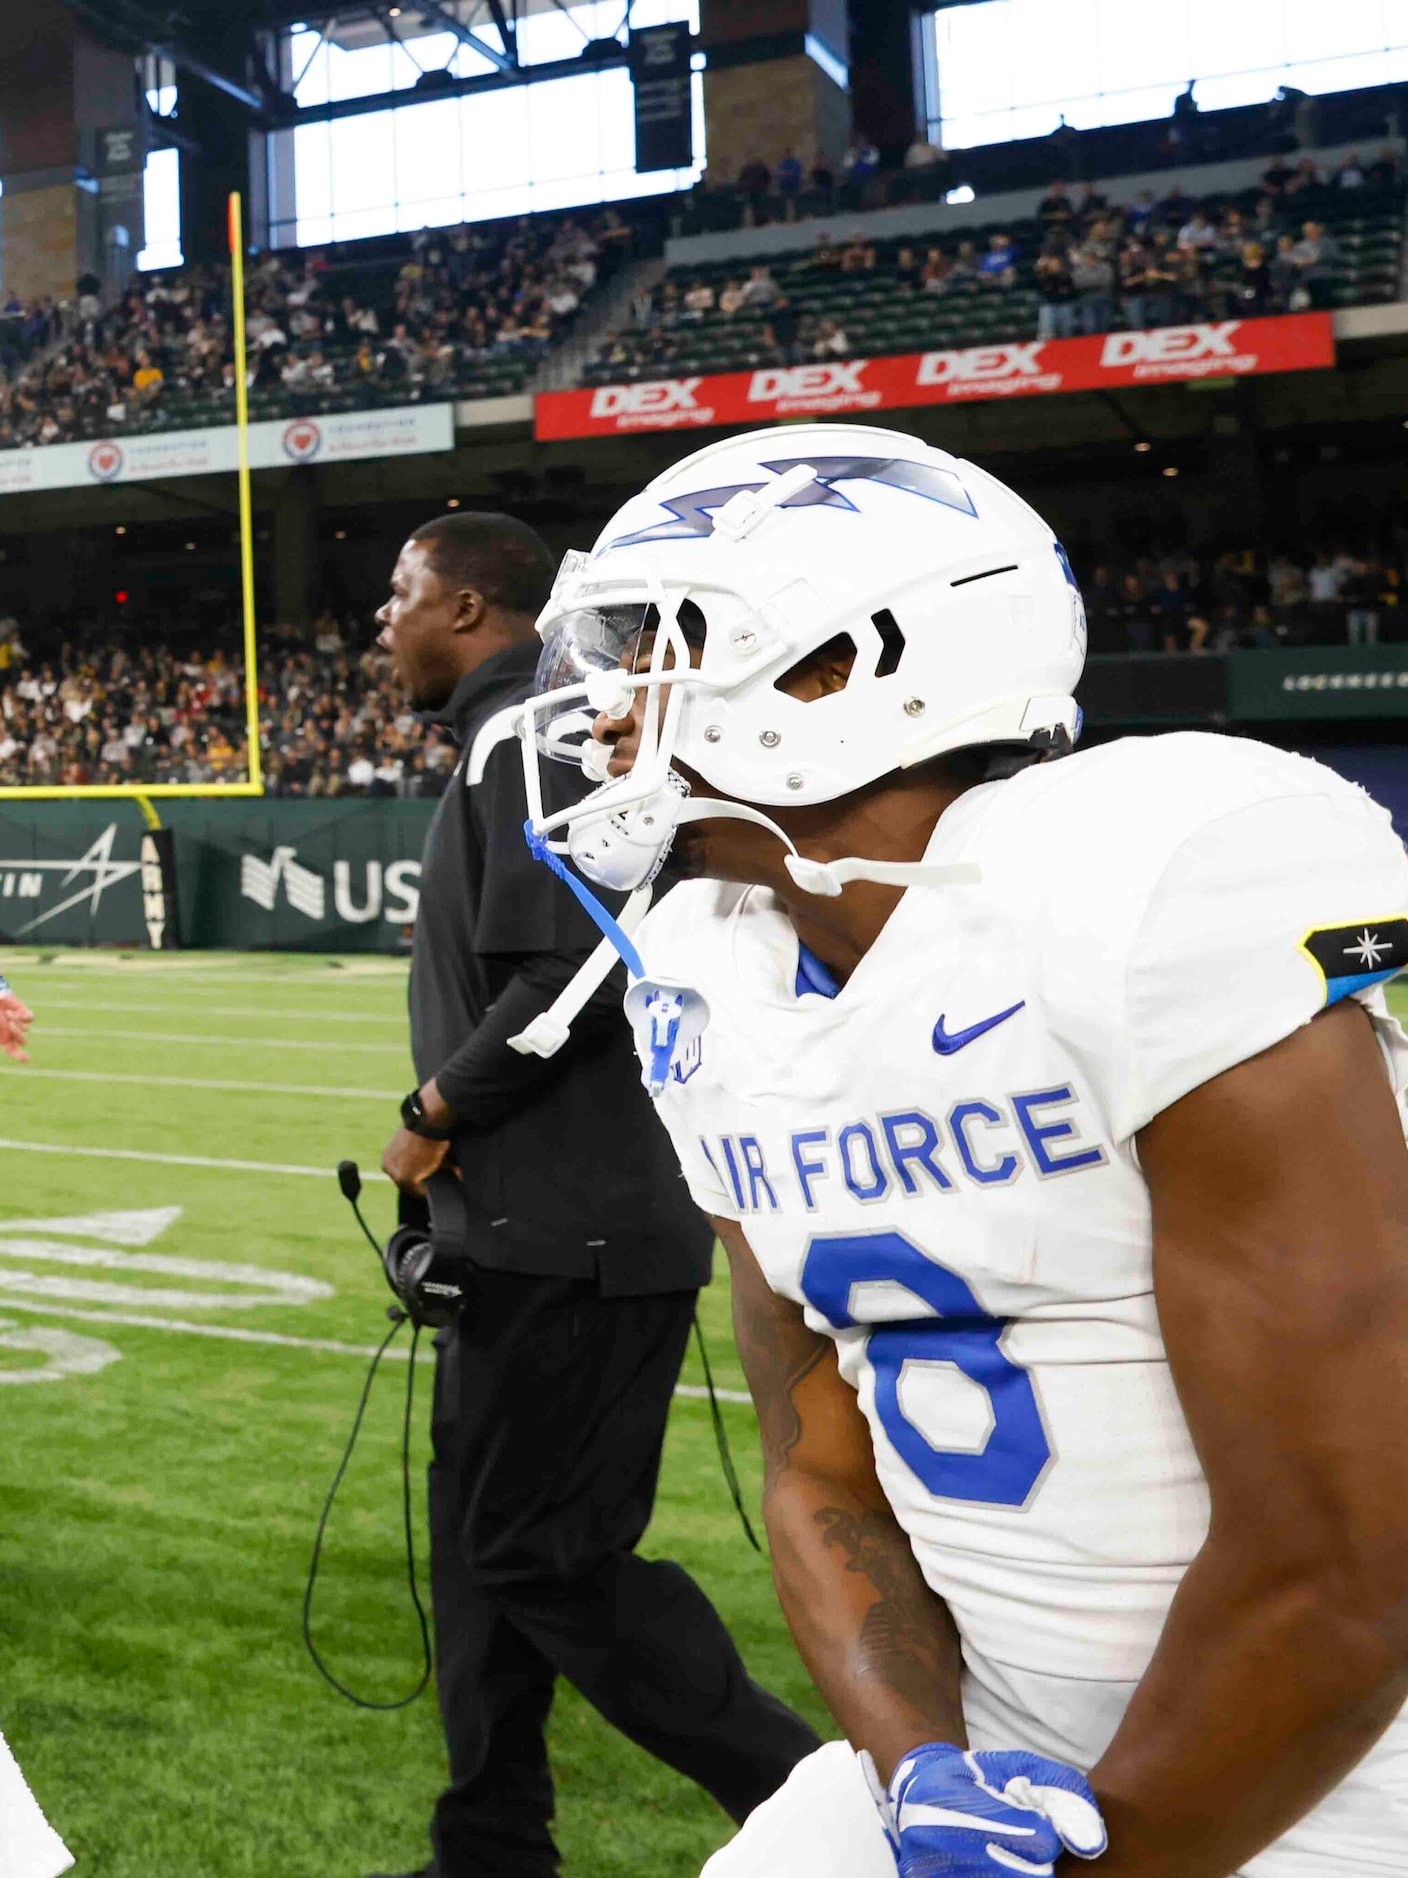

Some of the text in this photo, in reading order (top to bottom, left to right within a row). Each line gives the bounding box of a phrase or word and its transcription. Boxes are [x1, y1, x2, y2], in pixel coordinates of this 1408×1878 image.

[916, 340, 1047, 386] DEX
[1100, 320, 1242, 368] DEX
[590, 377, 704, 418] DEX
[747, 359, 871, 402] DEX
[141, 834, 166, 949] ARMY
[699, 1081, 1110, 1214] IR FORCE
[800, 1224, 1059, 1513] 8
